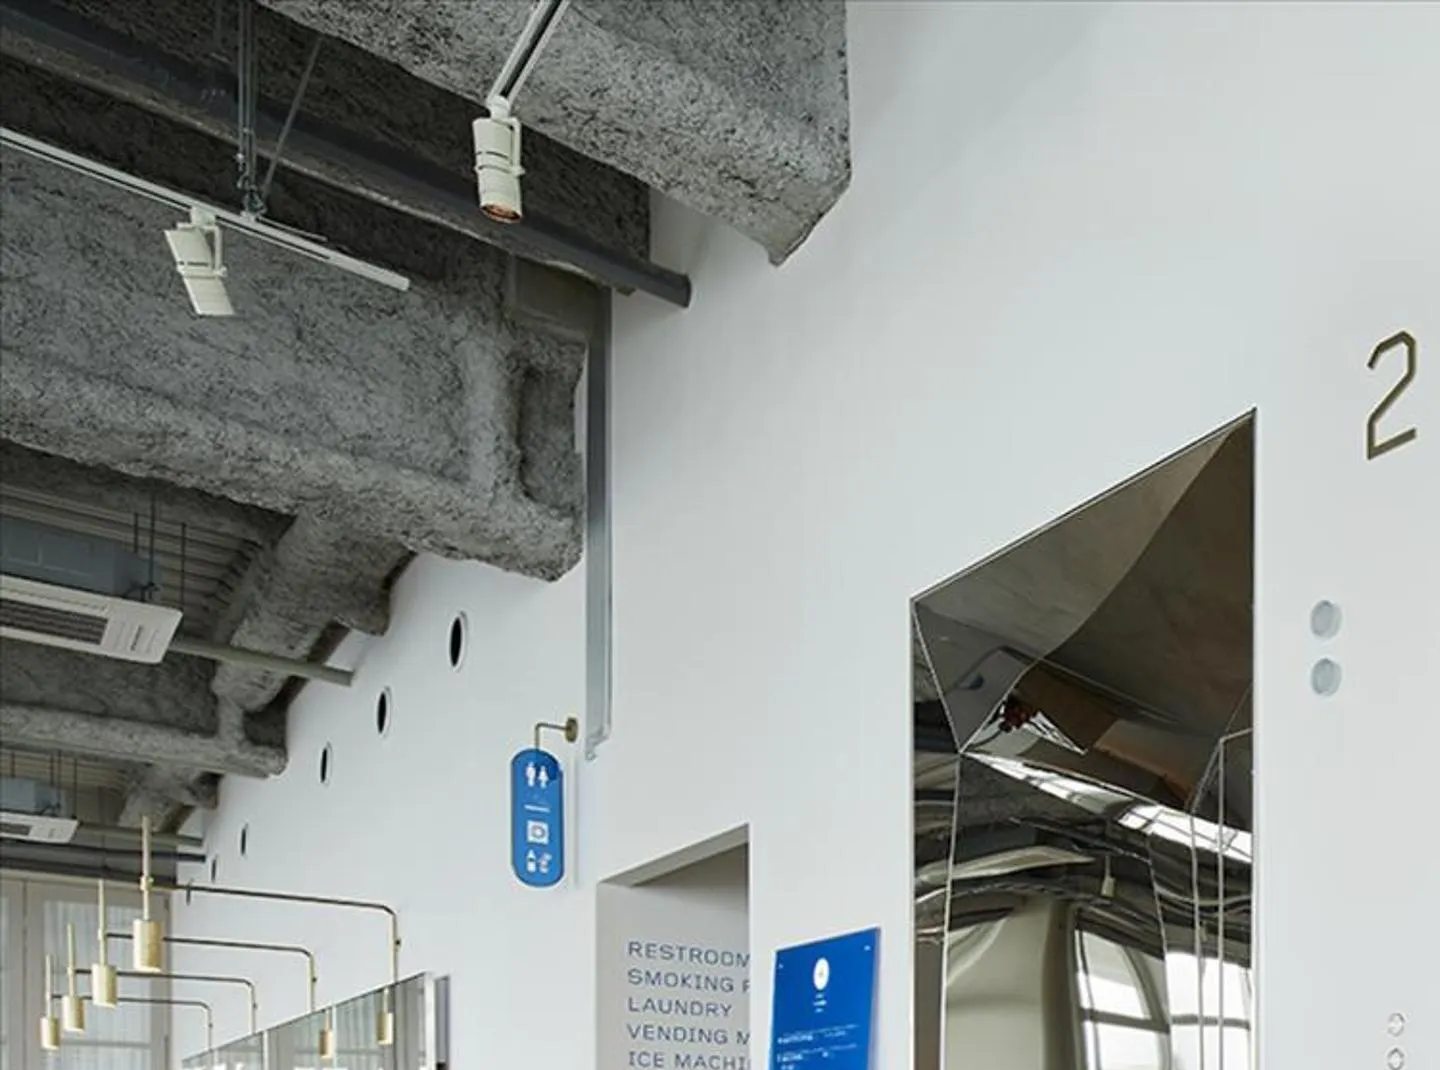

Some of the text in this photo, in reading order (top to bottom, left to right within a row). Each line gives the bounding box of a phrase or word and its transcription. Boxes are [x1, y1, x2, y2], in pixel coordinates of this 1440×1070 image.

[1366, 330, 1417, 461] 2
[627, 968, 734, 993] SMOKING
[628, 996, 732, 1016] LAUNDRY
[626, 1023, 728, 1045] VENDING
[628, 1051, 665, 1068] ICE
